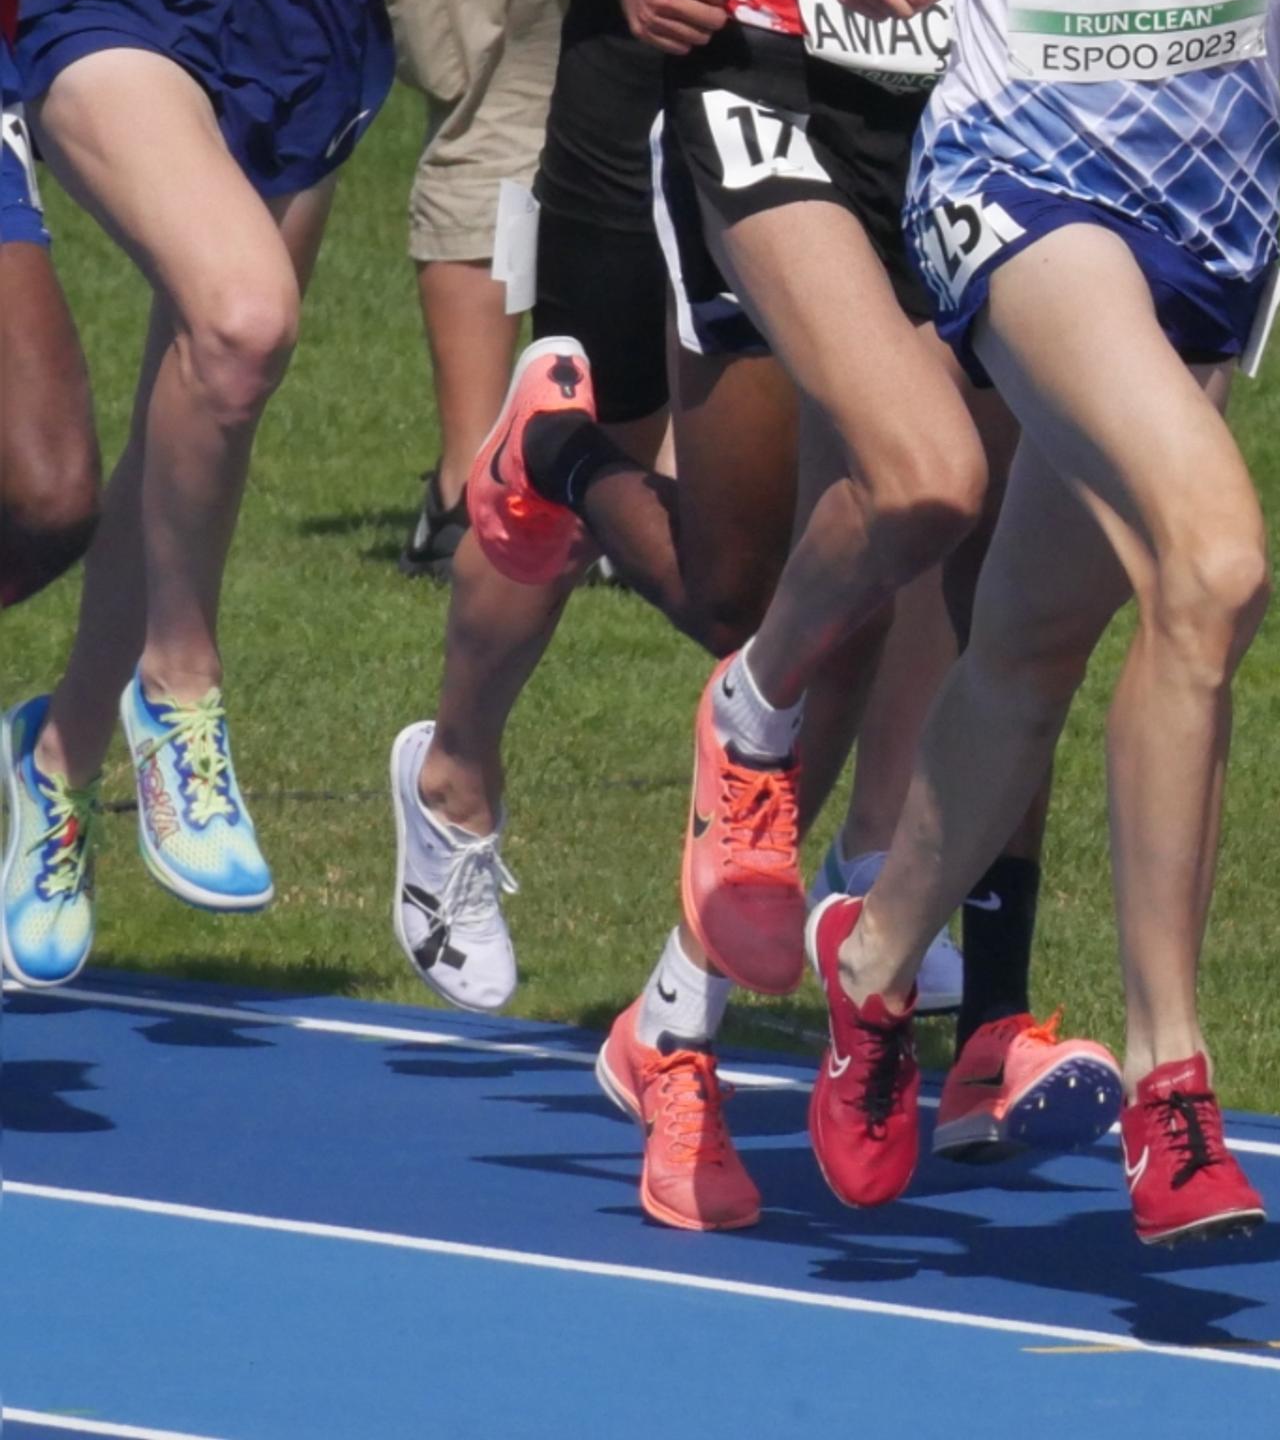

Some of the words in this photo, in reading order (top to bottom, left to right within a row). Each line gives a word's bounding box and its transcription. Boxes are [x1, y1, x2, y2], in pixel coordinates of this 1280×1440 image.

[1076, 14, 1129, 34] RUN
[1134, 8, 1212, 31] CLEAN
[1042, 43, 1158, 71] ESPOO
[1166, 30, 1237, 66] 2023
